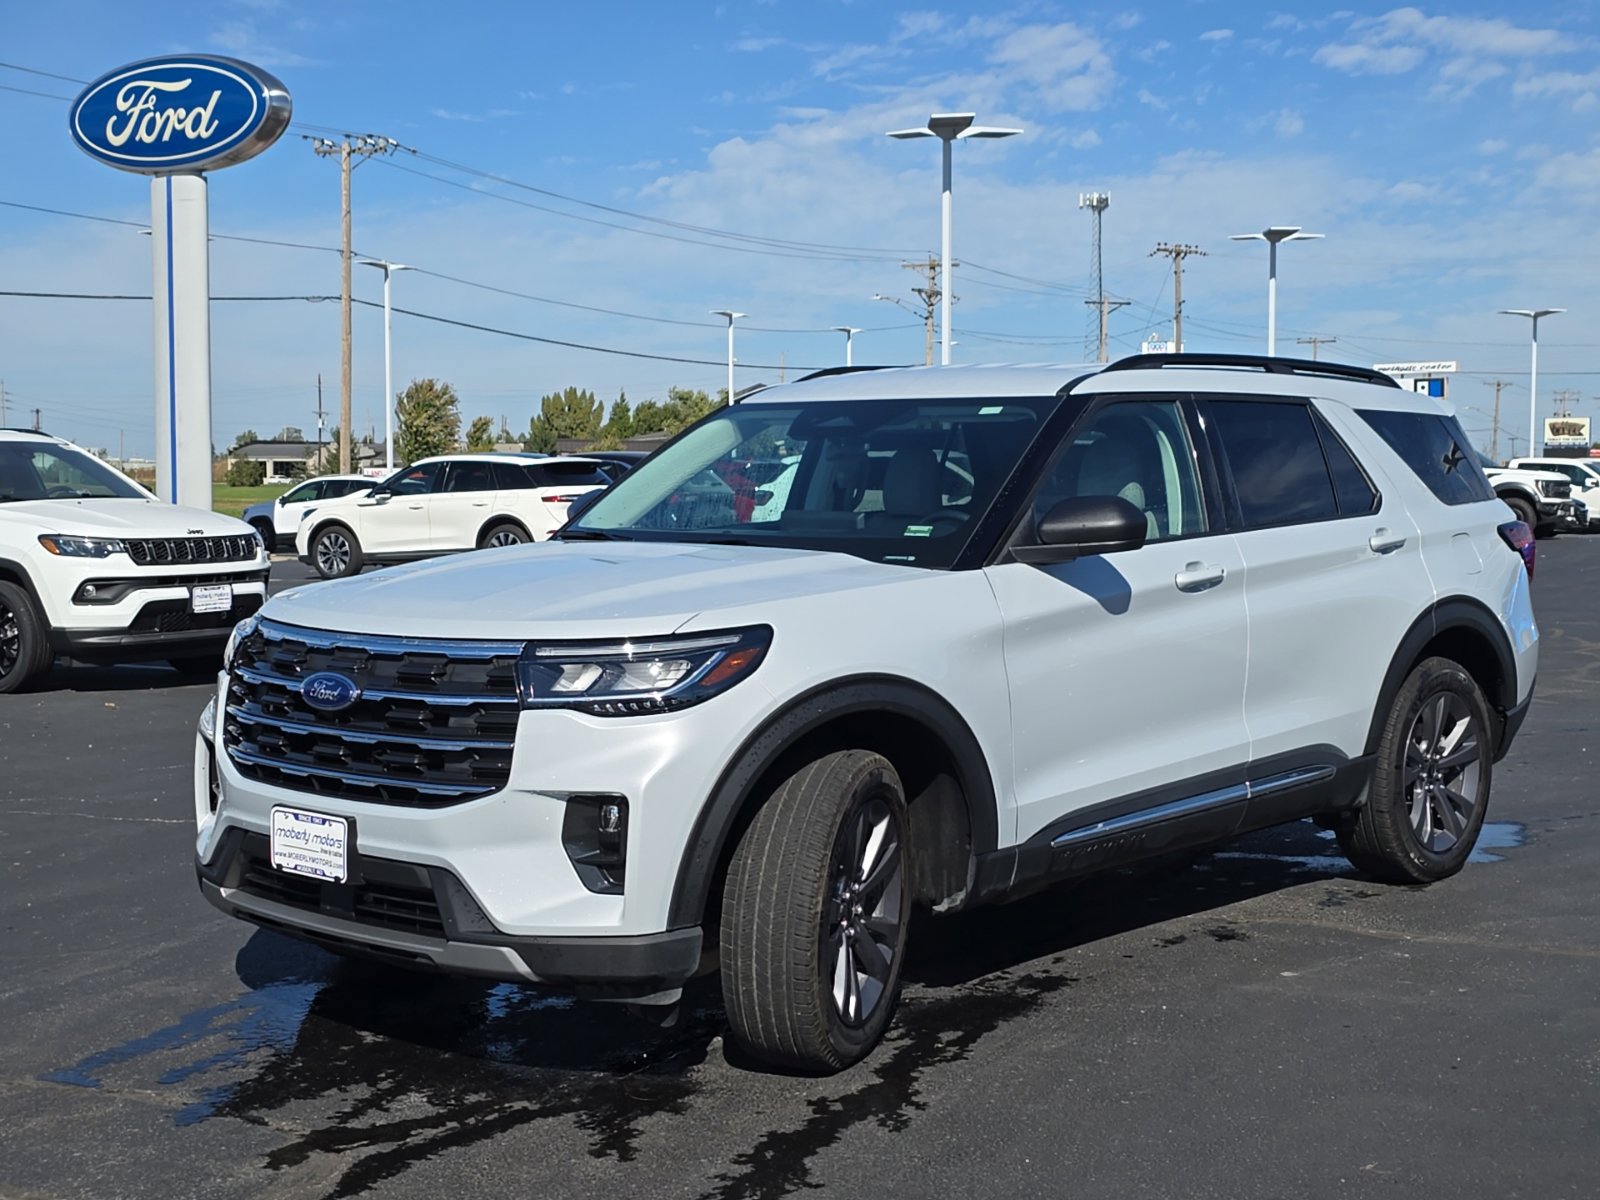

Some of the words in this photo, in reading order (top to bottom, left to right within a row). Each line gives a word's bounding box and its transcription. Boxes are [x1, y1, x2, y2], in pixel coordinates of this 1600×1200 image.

[106, 78, 222, 146] Ford
[310, 679, 342, 701] Ford
[275, 826, 310, 845] moberly
[312, 833, 343, 849] motors
